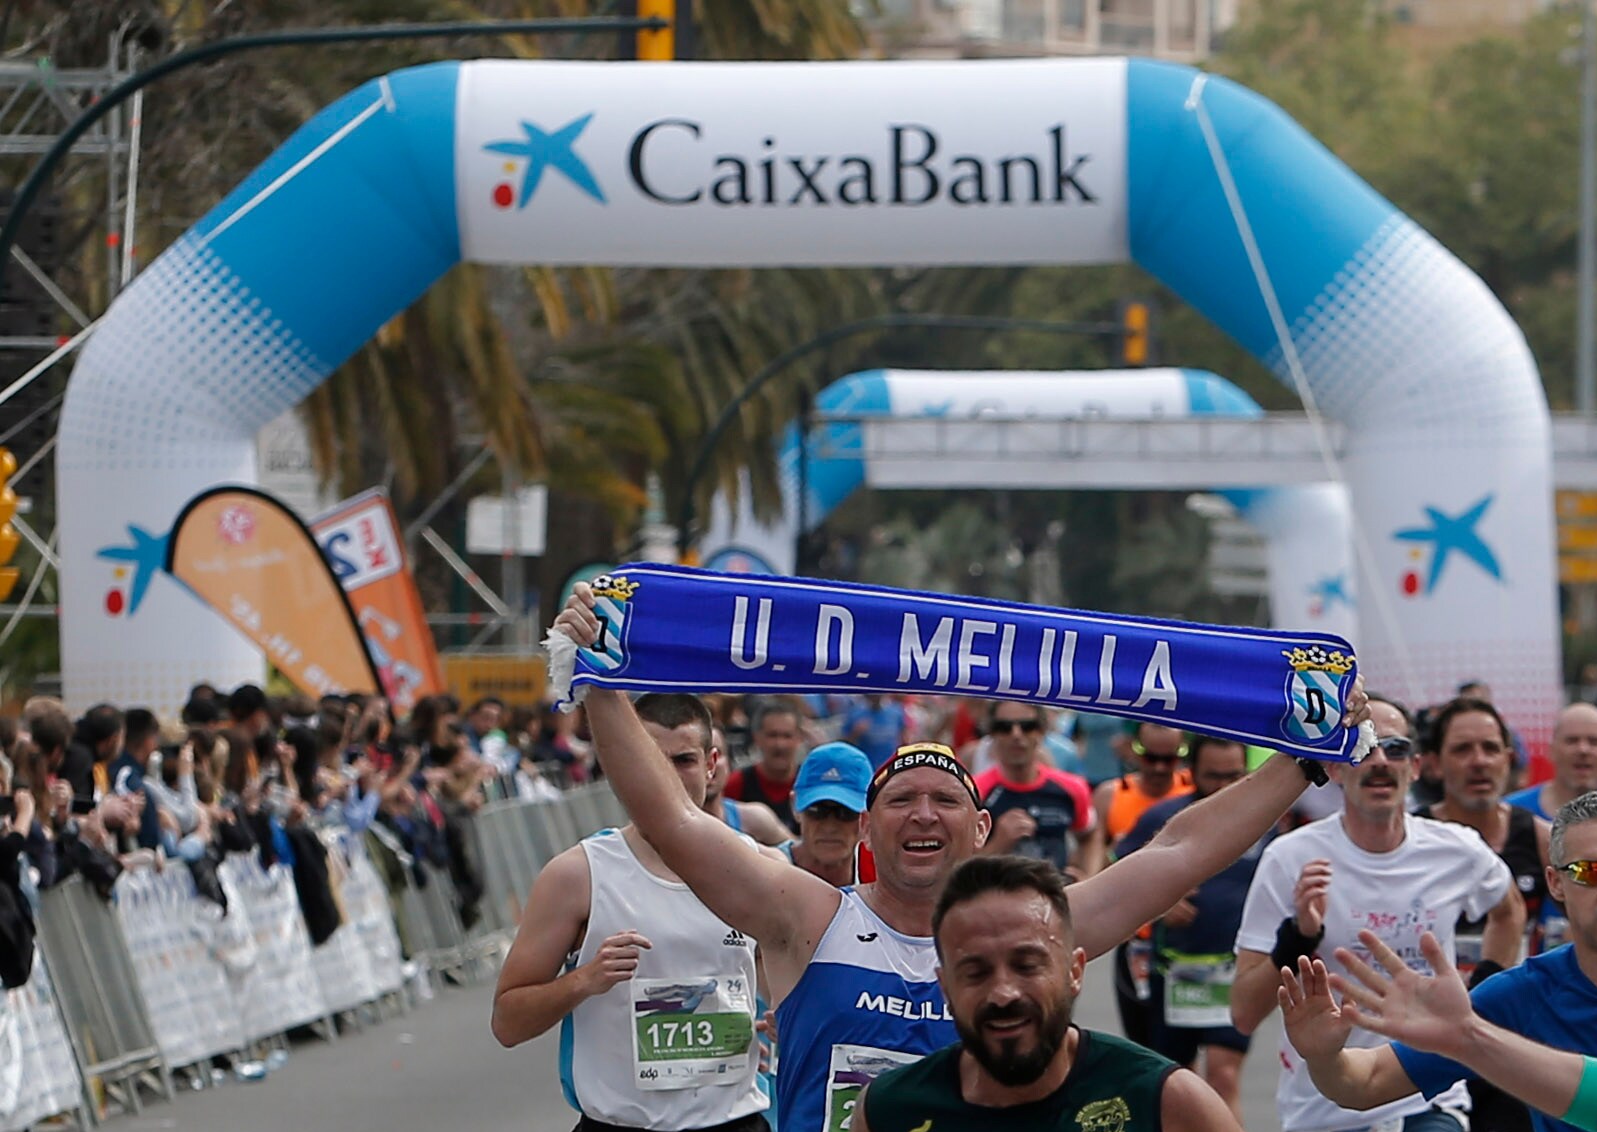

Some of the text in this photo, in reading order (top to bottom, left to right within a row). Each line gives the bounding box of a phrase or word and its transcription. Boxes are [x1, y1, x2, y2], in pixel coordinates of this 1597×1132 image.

[626, 117, 1100, 207] CaixaBank
[729, 596, 1179, 712] U. D. MELILLA
[893, 753, 959, 775] ESPAÑA
[723, 938, 747, 948] adidas
[855, 991, 954, 1021] MELILL
[647, 1020, 714, 1048] 1713
[639, 1068, 659, 1082] edp
